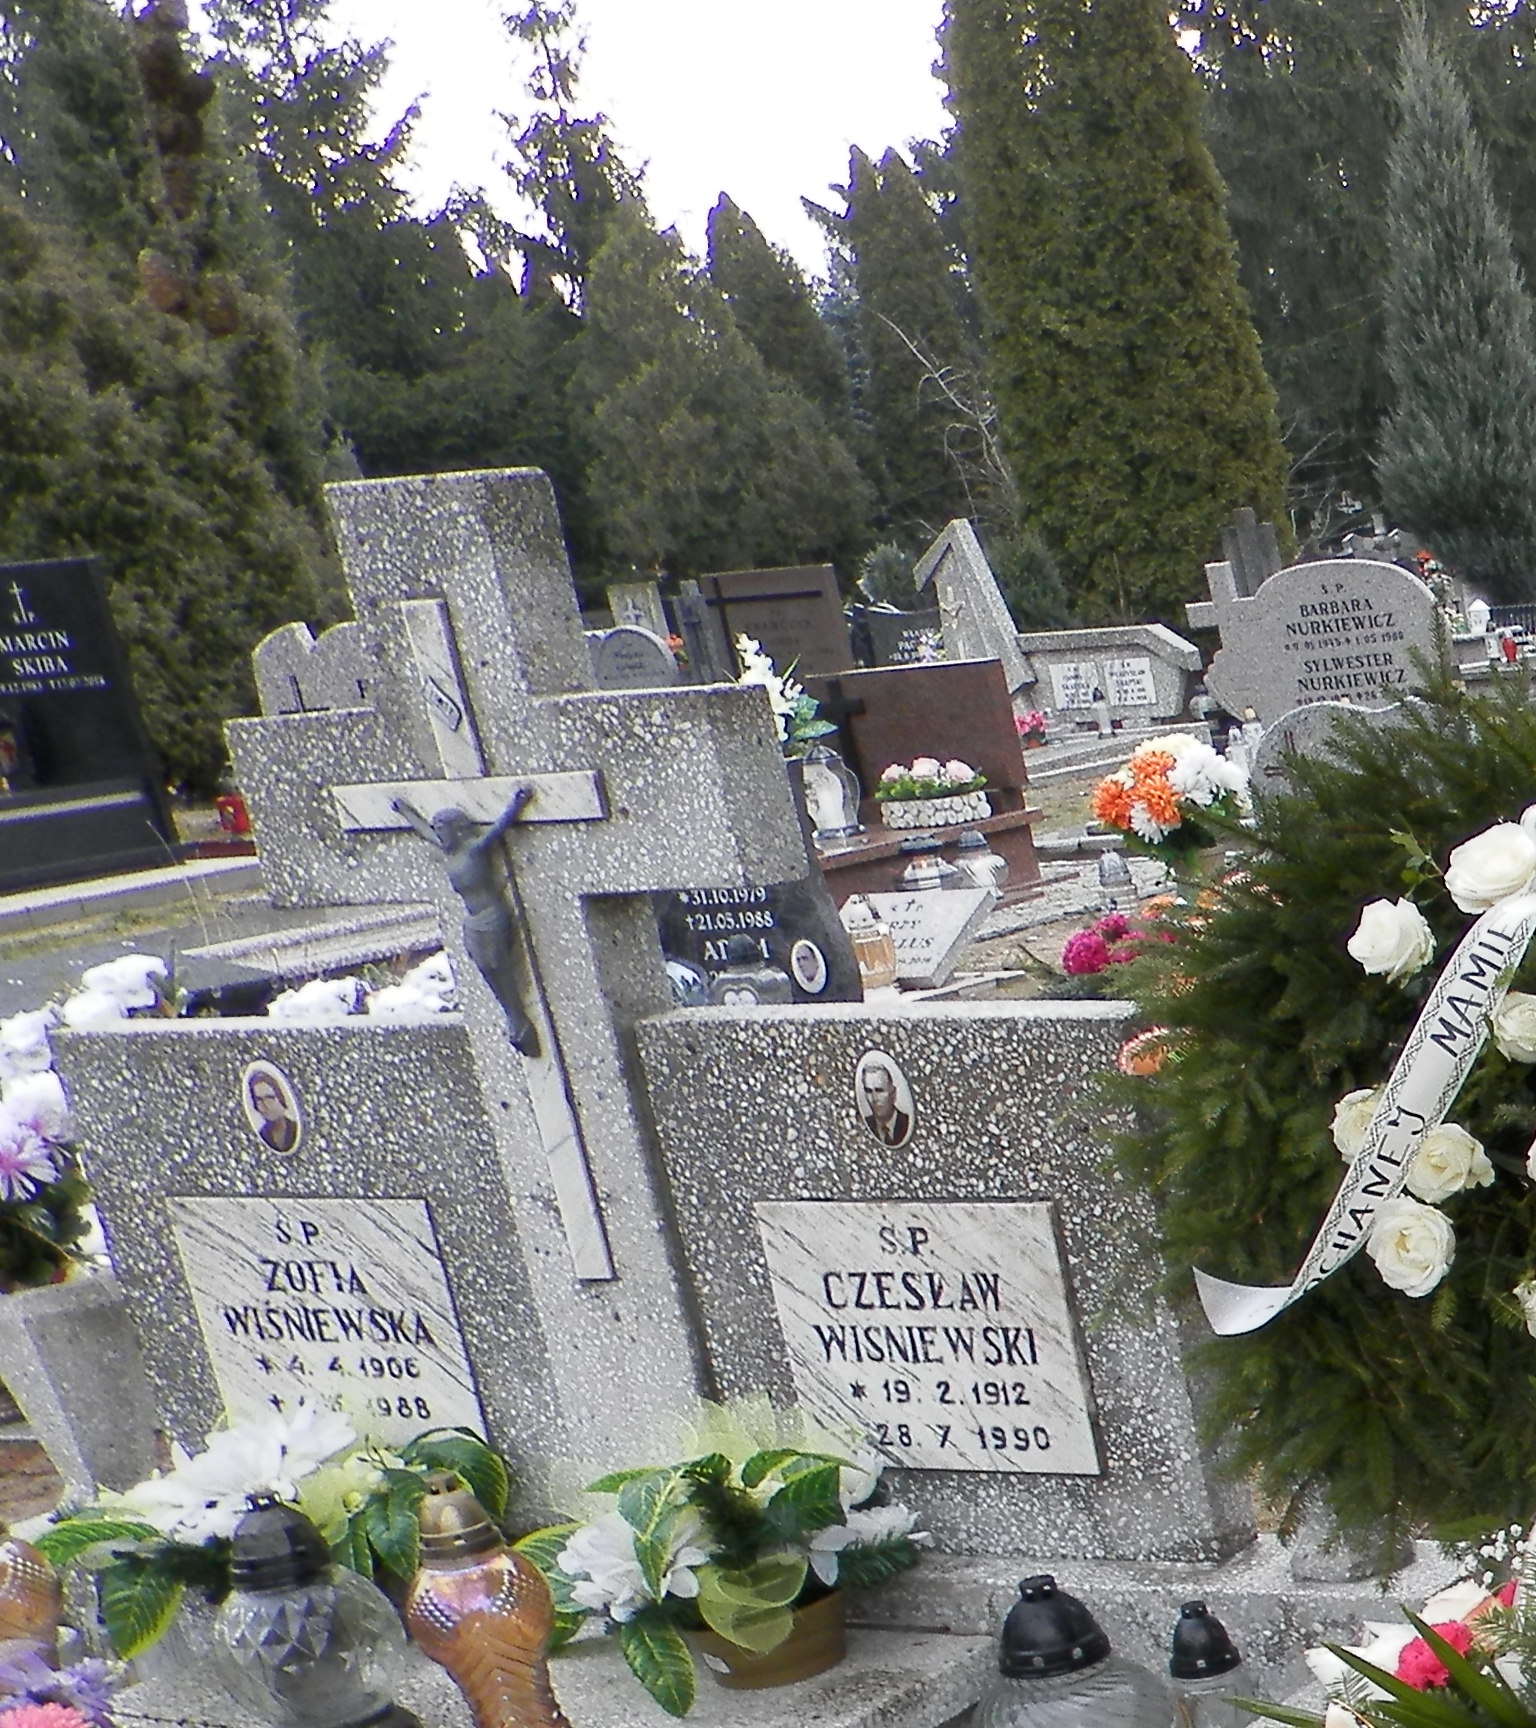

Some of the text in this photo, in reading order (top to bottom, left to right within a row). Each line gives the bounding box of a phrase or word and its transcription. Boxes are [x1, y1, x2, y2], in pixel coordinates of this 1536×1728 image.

[1299, 598, 1375, 619] BARBARA
[1285, 612, 1398, 638] NURKIEWICZ
[1302, 651, 1394, 675] SYLWESTER
[1296, 667, 1408, 693] NURKIEWICZ
[258, 1257, 370, 1295] ZOFIA
[820, 1271, 1002, 1313] CZESŁAW
[222, 1300, 439, 1349] WIŚNIEWSKA
[975, 1424, 1053, 1451] 1990
